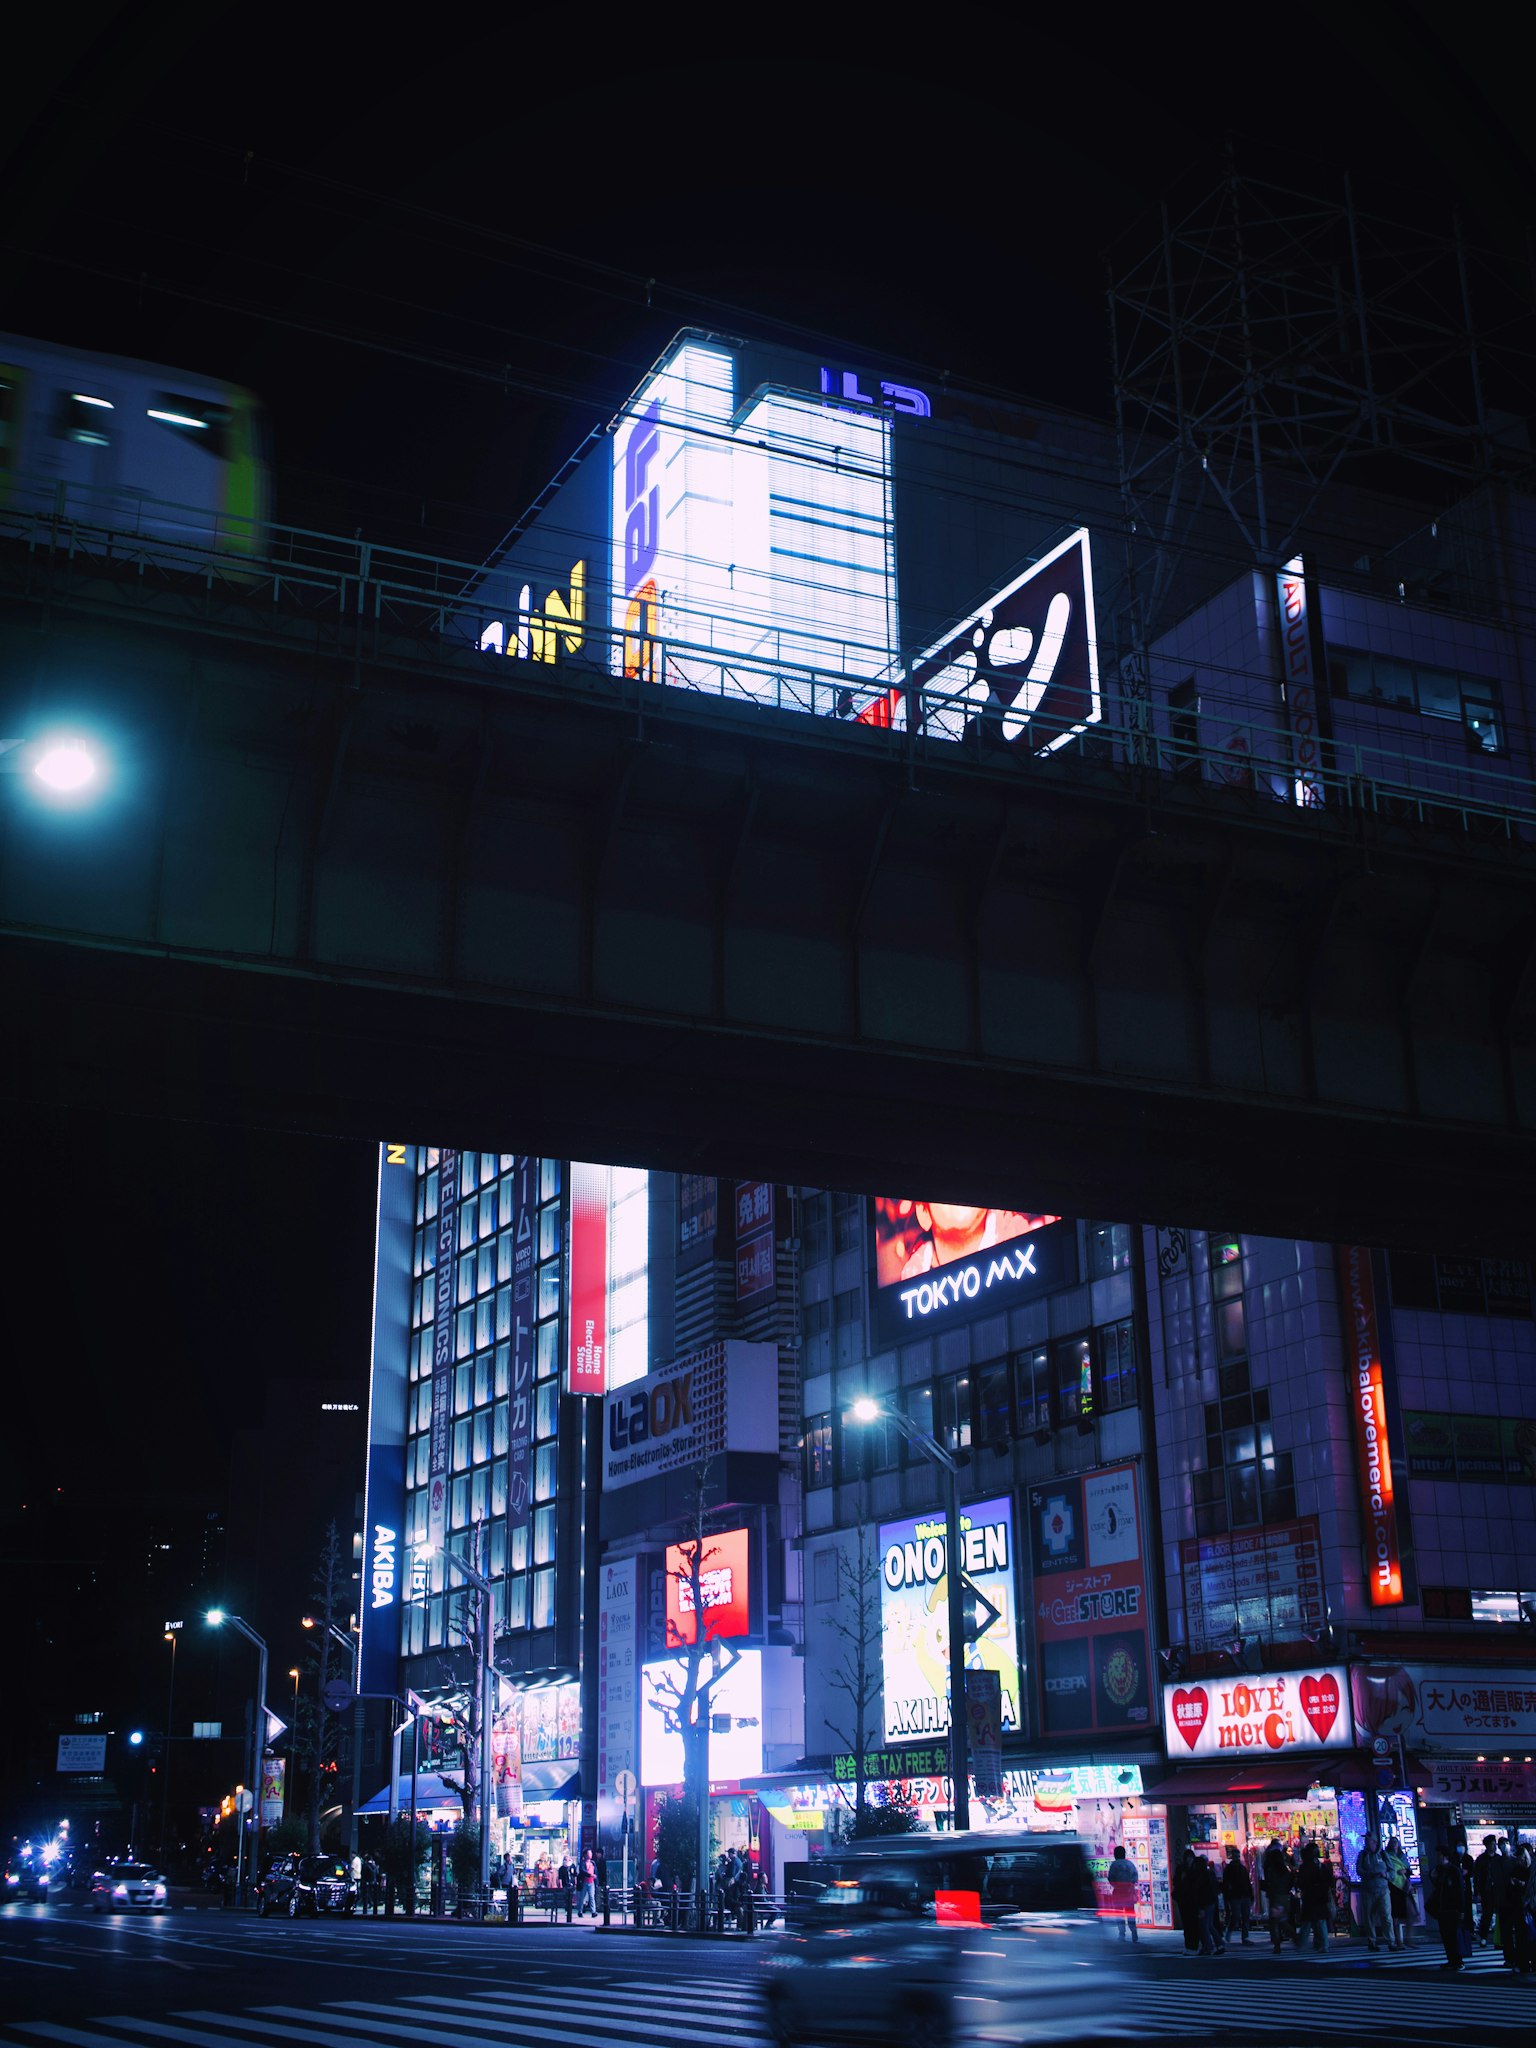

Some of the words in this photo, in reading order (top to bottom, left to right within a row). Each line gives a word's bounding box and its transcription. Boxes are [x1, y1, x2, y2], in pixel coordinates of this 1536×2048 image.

[1282, 581, 1309, 678] ADULT
[516, 1155, 531, 1244] ーム
[515, 1245, 531, 1261] VIDEO
[434, 1185, 455, 1367] ELECTRONICS
[515, 1259, 531, 1273] GAME
[901, 1266, 980, 1318] TOKYO
[986, 1243, 1037, 1288] MX
[584, 1319, 594, 1374] Electronics
[576, 1346, 584, 1374] Store
[593, 1345, 601, 1375] Home
[512, 1315, 528, 1431] トレカ
[1032, 1491, 1043, 1507] 5F
[371, 1525, 396, 1609] AKIBA
[606, 1581, 629, 1600] LAOX
[1065, 1573, 1112, 1593] ジーストア
[1177, 1702, 1203, 1719] 秋葉原
[1221, 1682, 1285, 1718] LOVE
[1307, 1706, 1321, 1715] CLOSE
[1308, 1695, 1320, 1704] OPEN
[888, 1689, 1016, 1738] AKIHAA
[1464, 1714, 1510, 1728] やってます
[1375, 1740, 1387, 1751] 20
[881, 1753, 903, 1775] TAX
[905, 1751, 932, 1774] FREE
[1436, 1775, 1525, 1793] ラブメルシー
